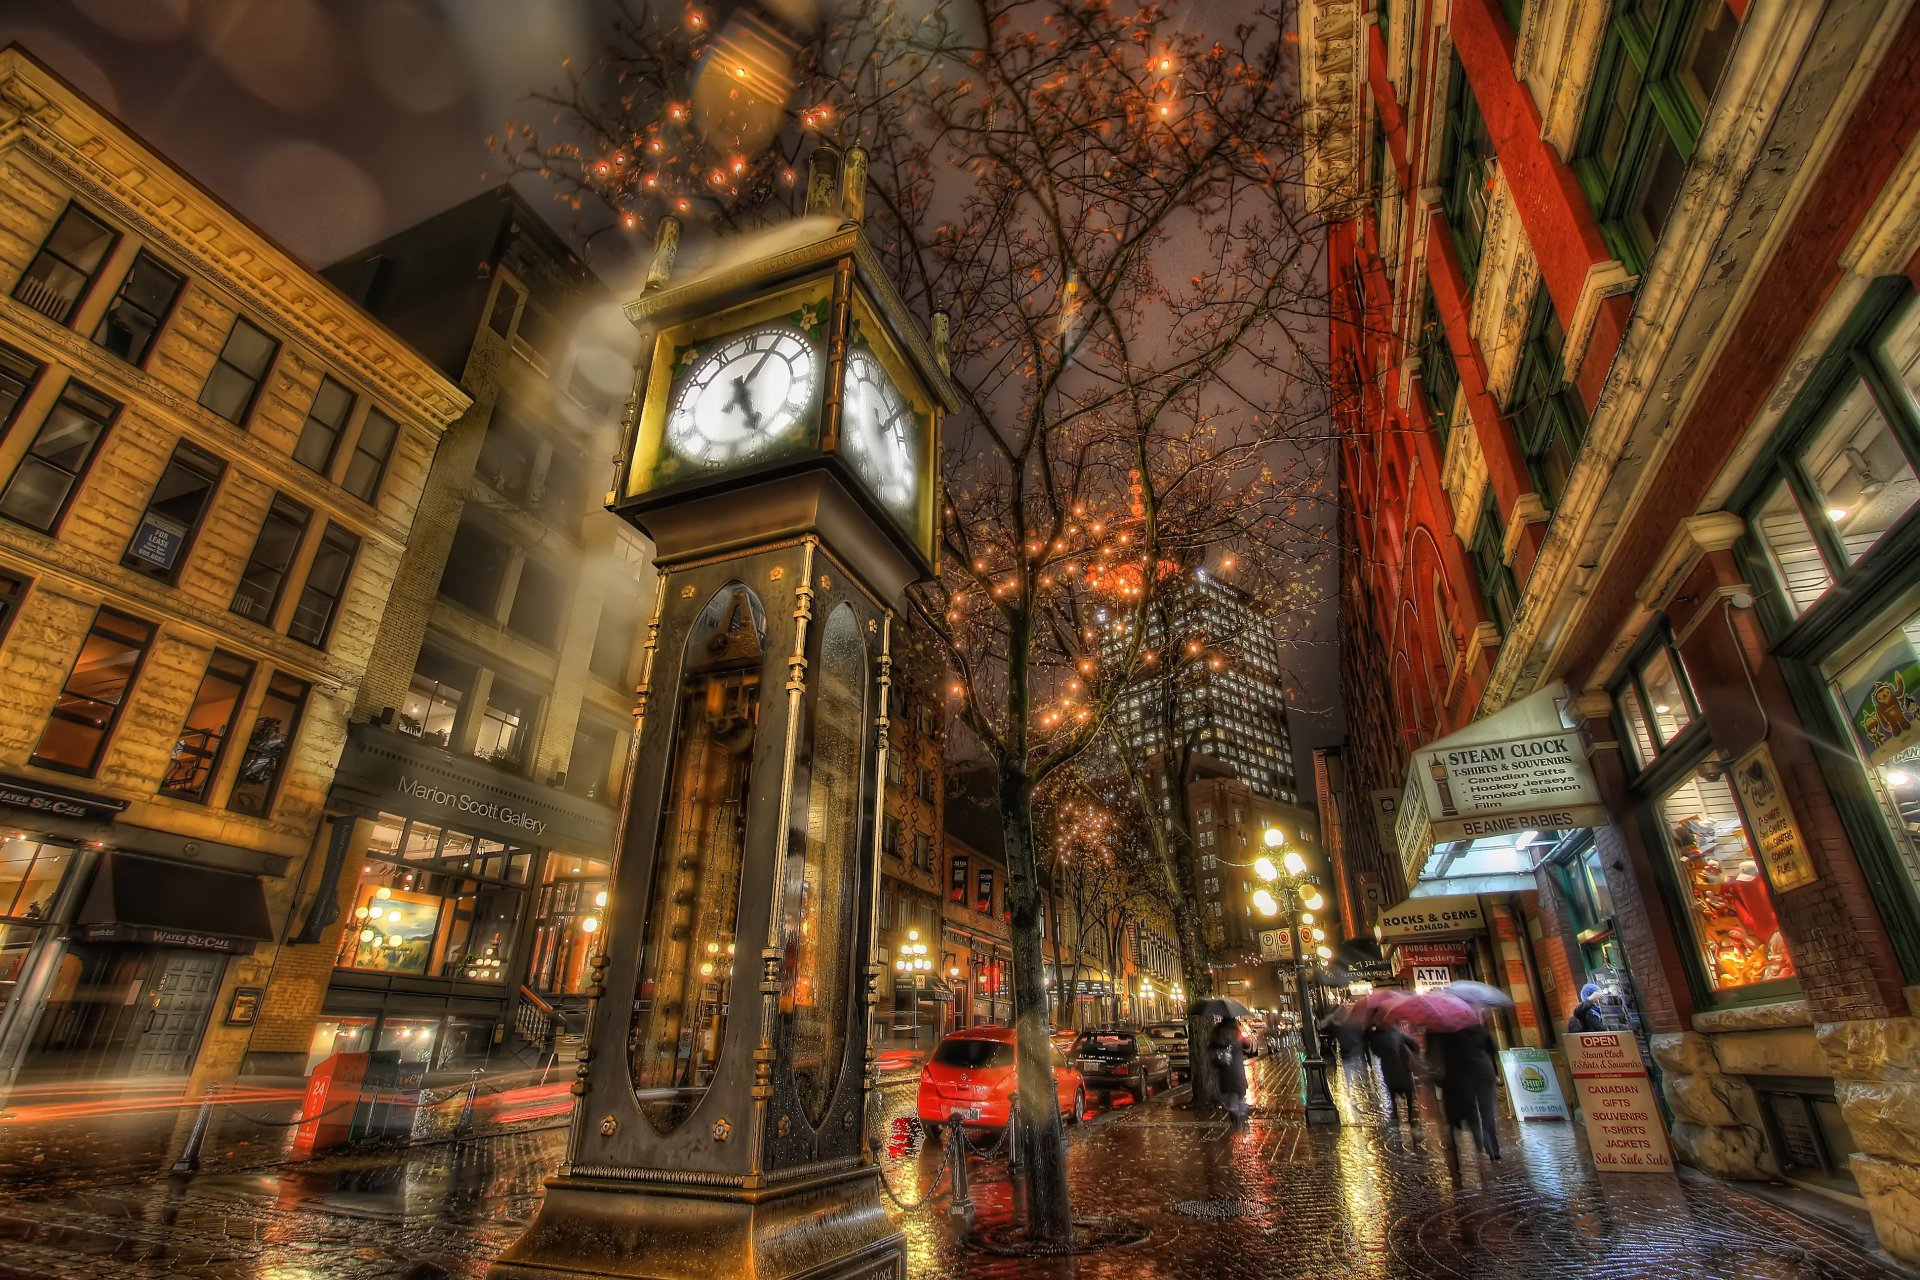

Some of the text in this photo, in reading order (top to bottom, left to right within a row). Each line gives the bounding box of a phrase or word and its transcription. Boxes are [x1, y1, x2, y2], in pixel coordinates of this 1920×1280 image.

[155, 530, 169, 540] FOR
[149, 535, 169, 548] LEASE
[1448, 739, 1568, 766] STEAM CLOCK
[1452, 756, 1572, 777] T-SHIRTS & SOUVENIRS
[1468, 768, 1566, 784] Canadian Gifts
[1470, 776, 1576, 793] Hockey Jerseys
[1473, 784, 1581, 801] Smoked Salmon
[398, 776, 547, 836] Marion Scott Gallery
[1475, 801, 1502, 810] Film
[1463, 812, 1573, 836] BEANIE BABIES
[1383, 909, 1478, 927] ROCKS & GEMS
[1413, 922, 1450, 932] CANADA
[1404, 943, 1461, 952] FUDGE GELATO
[1414, 954, 1456, 963] Jewellery
[1417, 969, 1447, 980] ATM
[1583, 1036, 1617, 1047] OPEN
[1581, 1049, 1625, 1059] Steam Clock
[1600, 1060, 1606, 1069] &
[1607, 1059, 1642, 1069] Souvenirs
[312, 1081, 326, 1095] 24
[1588, 1085, 1639, 1094] CANADIAN
[1602, 1099, 1631, 1107] GIFTS
[1592, 1112, 1648, 1120] SOUVENIRS
[1602, 1126, 1646, 1135] T-SHIRTS
[1605, 1139, 1651, 1148] JACKETS
[1595, 1152, 1669, 1165] Sale Sale Sale
